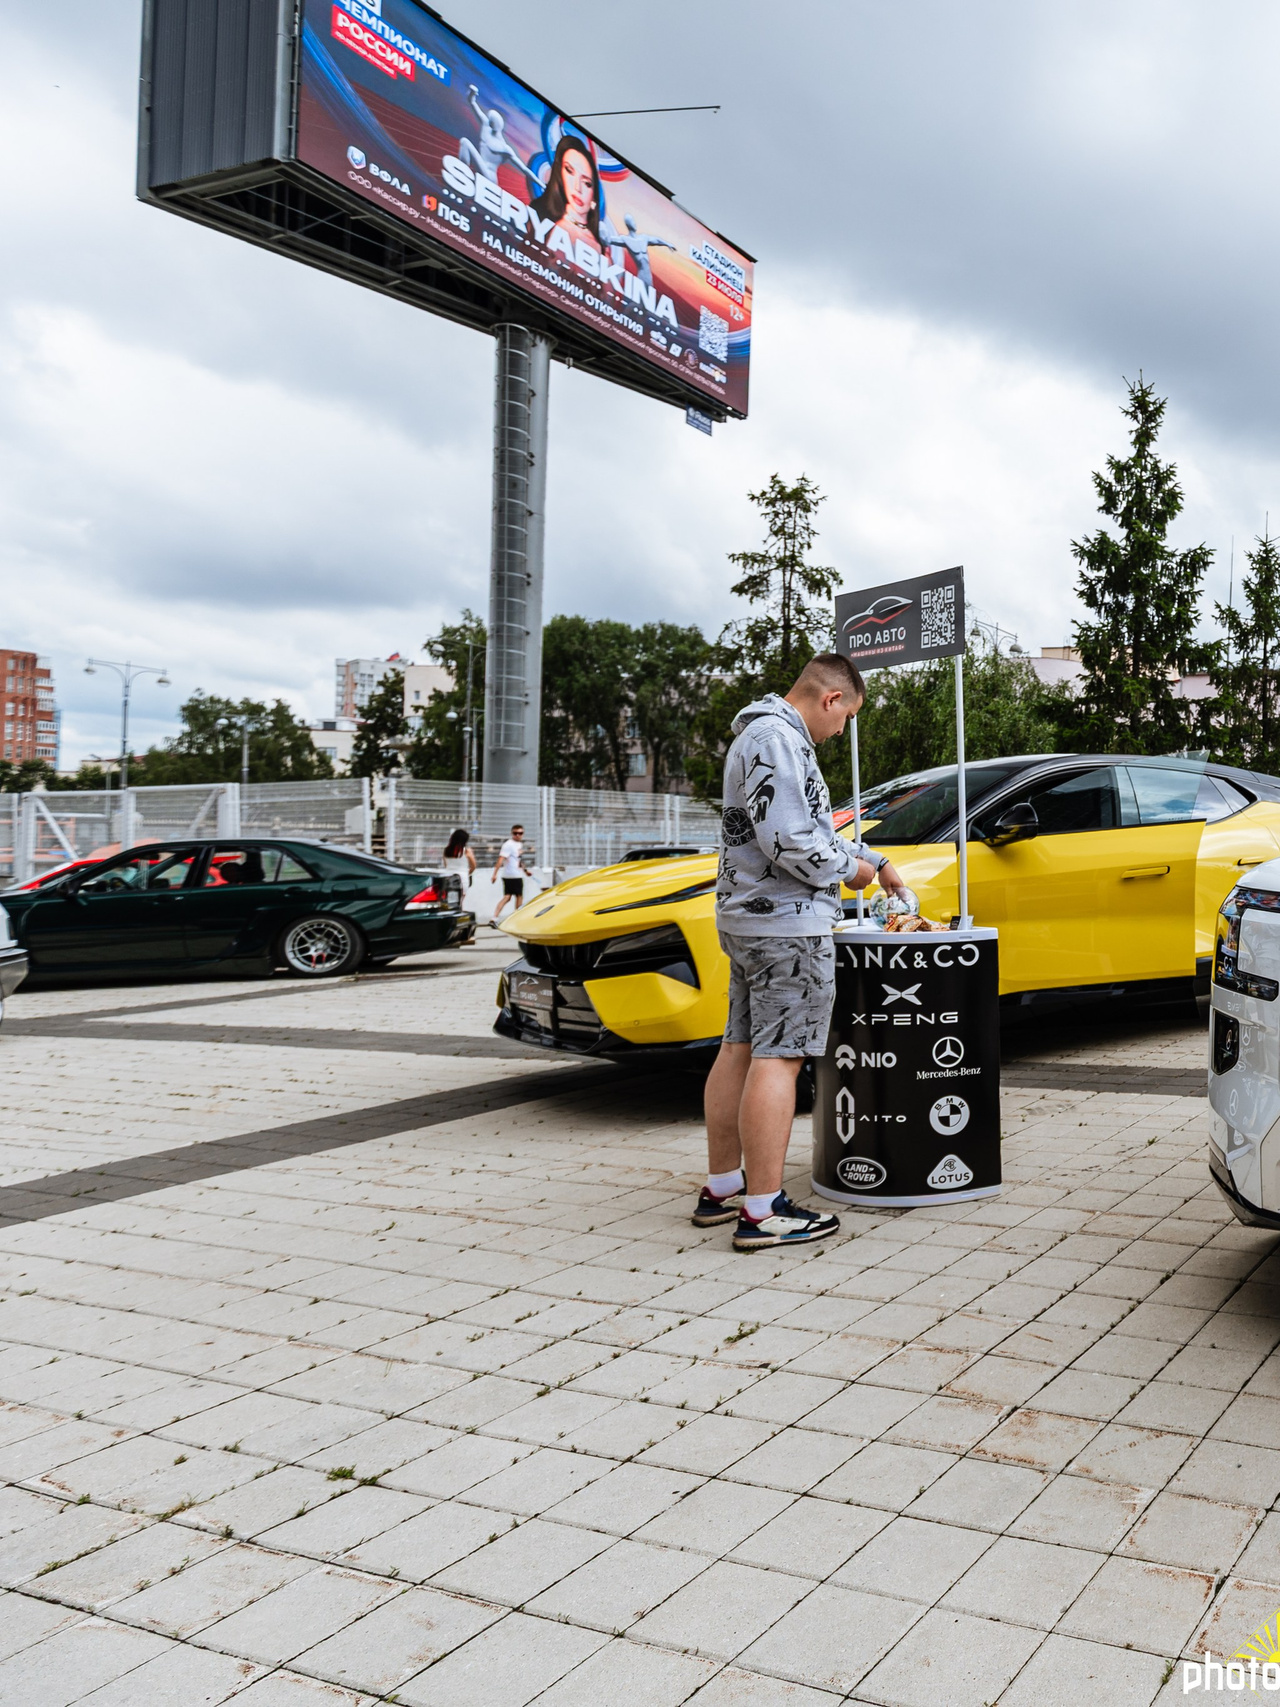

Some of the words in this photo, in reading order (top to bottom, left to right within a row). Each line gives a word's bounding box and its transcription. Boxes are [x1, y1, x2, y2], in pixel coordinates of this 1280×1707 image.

[337, 13, 411, 75] РОССИИ
[368, 162, 411, 196] ВФЛА
[437, 202, 471, 233] ПСБ
[441, 154, 679, 329] SERYABKINA
[704, 245, 744, 279] СТАДИОН
[482, 231, 503, 253] НА
[505, 245, 584, 300] ЦЕРЕМОНИИ
[585, 293, 644, 336] ОТКРЫТИЯ
[707, 274, 717, 286] 23
[717, 280, 743, 305] ИЮЛЯ
[729, 304, 745, 321] 12+
[849, 632, 872, 649] ПРО
[874, 626, 907, 645] АВТО
[852, 1011, 959, 1026] XPENG
[861, 1052, 897, 1068] NIO
[916, 1067, 981, 1080] Mercedes-Benz
[934, 1097, 966, 1111] BMW
[859, 1114, 907, 1123] AITO
[845, 1163, 869, 1173] LAND
[847, 1172, 877, 1183] ROVER
[931, 1172, 970, 1185] LOTUS
